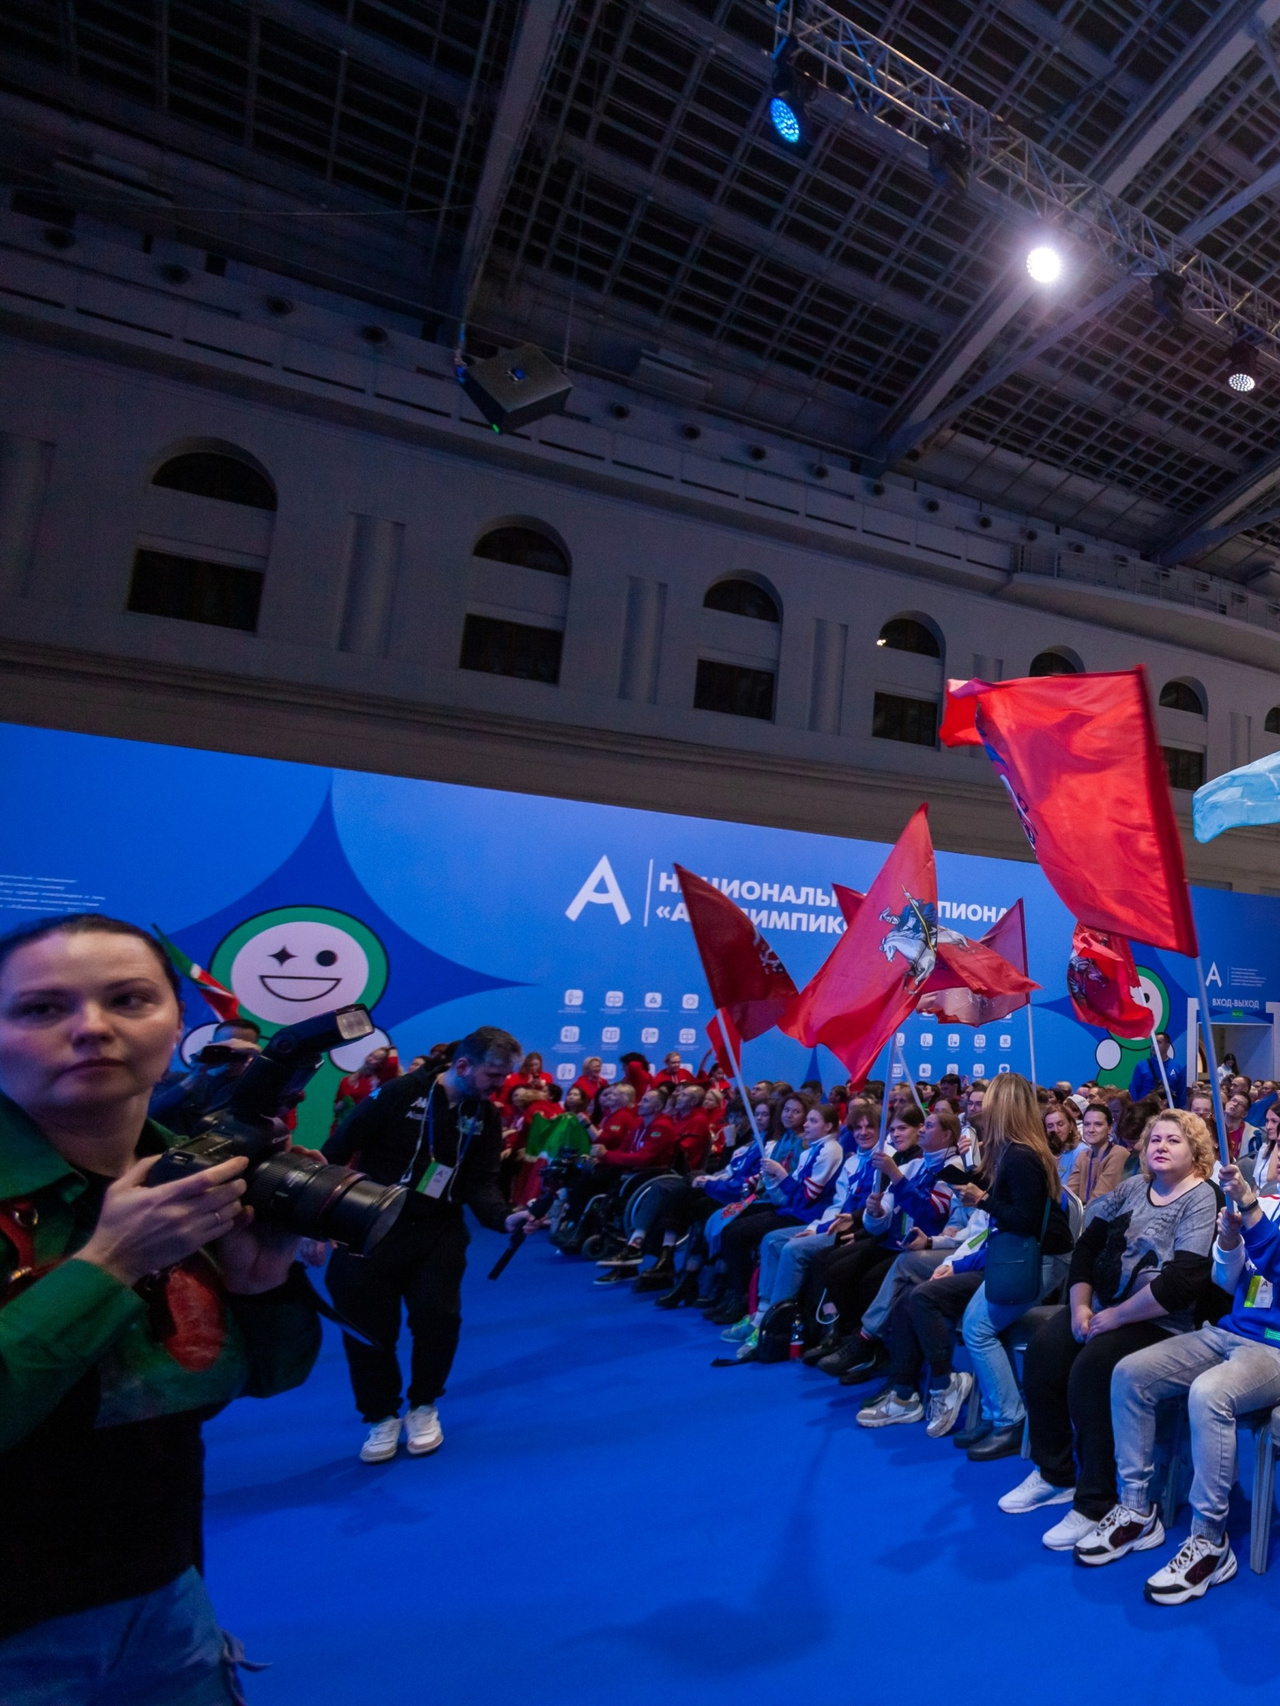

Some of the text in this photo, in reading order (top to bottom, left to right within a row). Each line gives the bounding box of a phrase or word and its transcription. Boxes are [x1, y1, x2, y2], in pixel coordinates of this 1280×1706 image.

[658, 871, 840, 908] НИОНАЛЬ
[655, 902, 849, 935] «АИМПИК
[1212, 997, 1260, 1009] ВХОД-ВЫХОД
